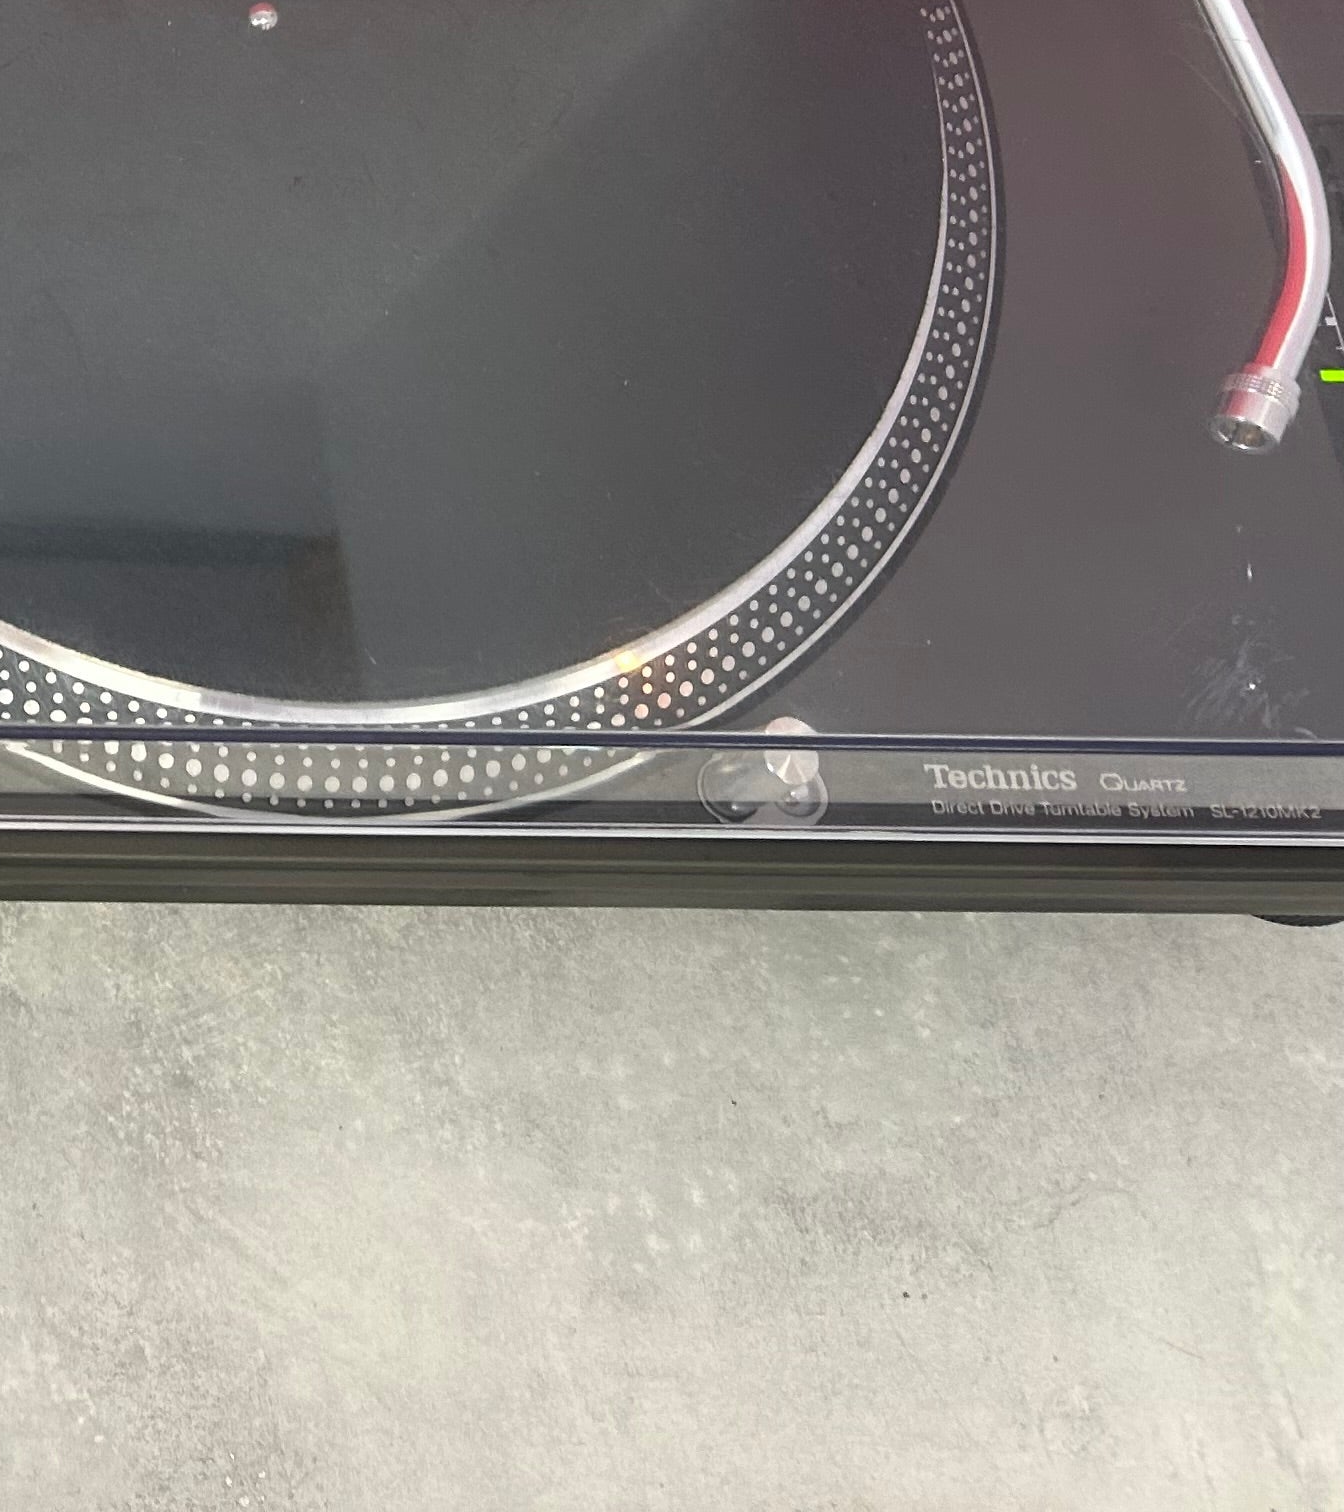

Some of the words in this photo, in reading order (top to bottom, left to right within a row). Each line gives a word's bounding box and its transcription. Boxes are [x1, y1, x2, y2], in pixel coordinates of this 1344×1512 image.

[923, 763, 1078, 791] Technics
[1099, 772, 1188, 792] QUARTZ
[930, 799, 985, 816] Direct
[989, 800, 1036, 817] Drive
[1038, 800, 1123, 818] Turntable
[1127, 801, 1195, 820] System
[1209, 803, 1323, 820] SL-1210MK2
